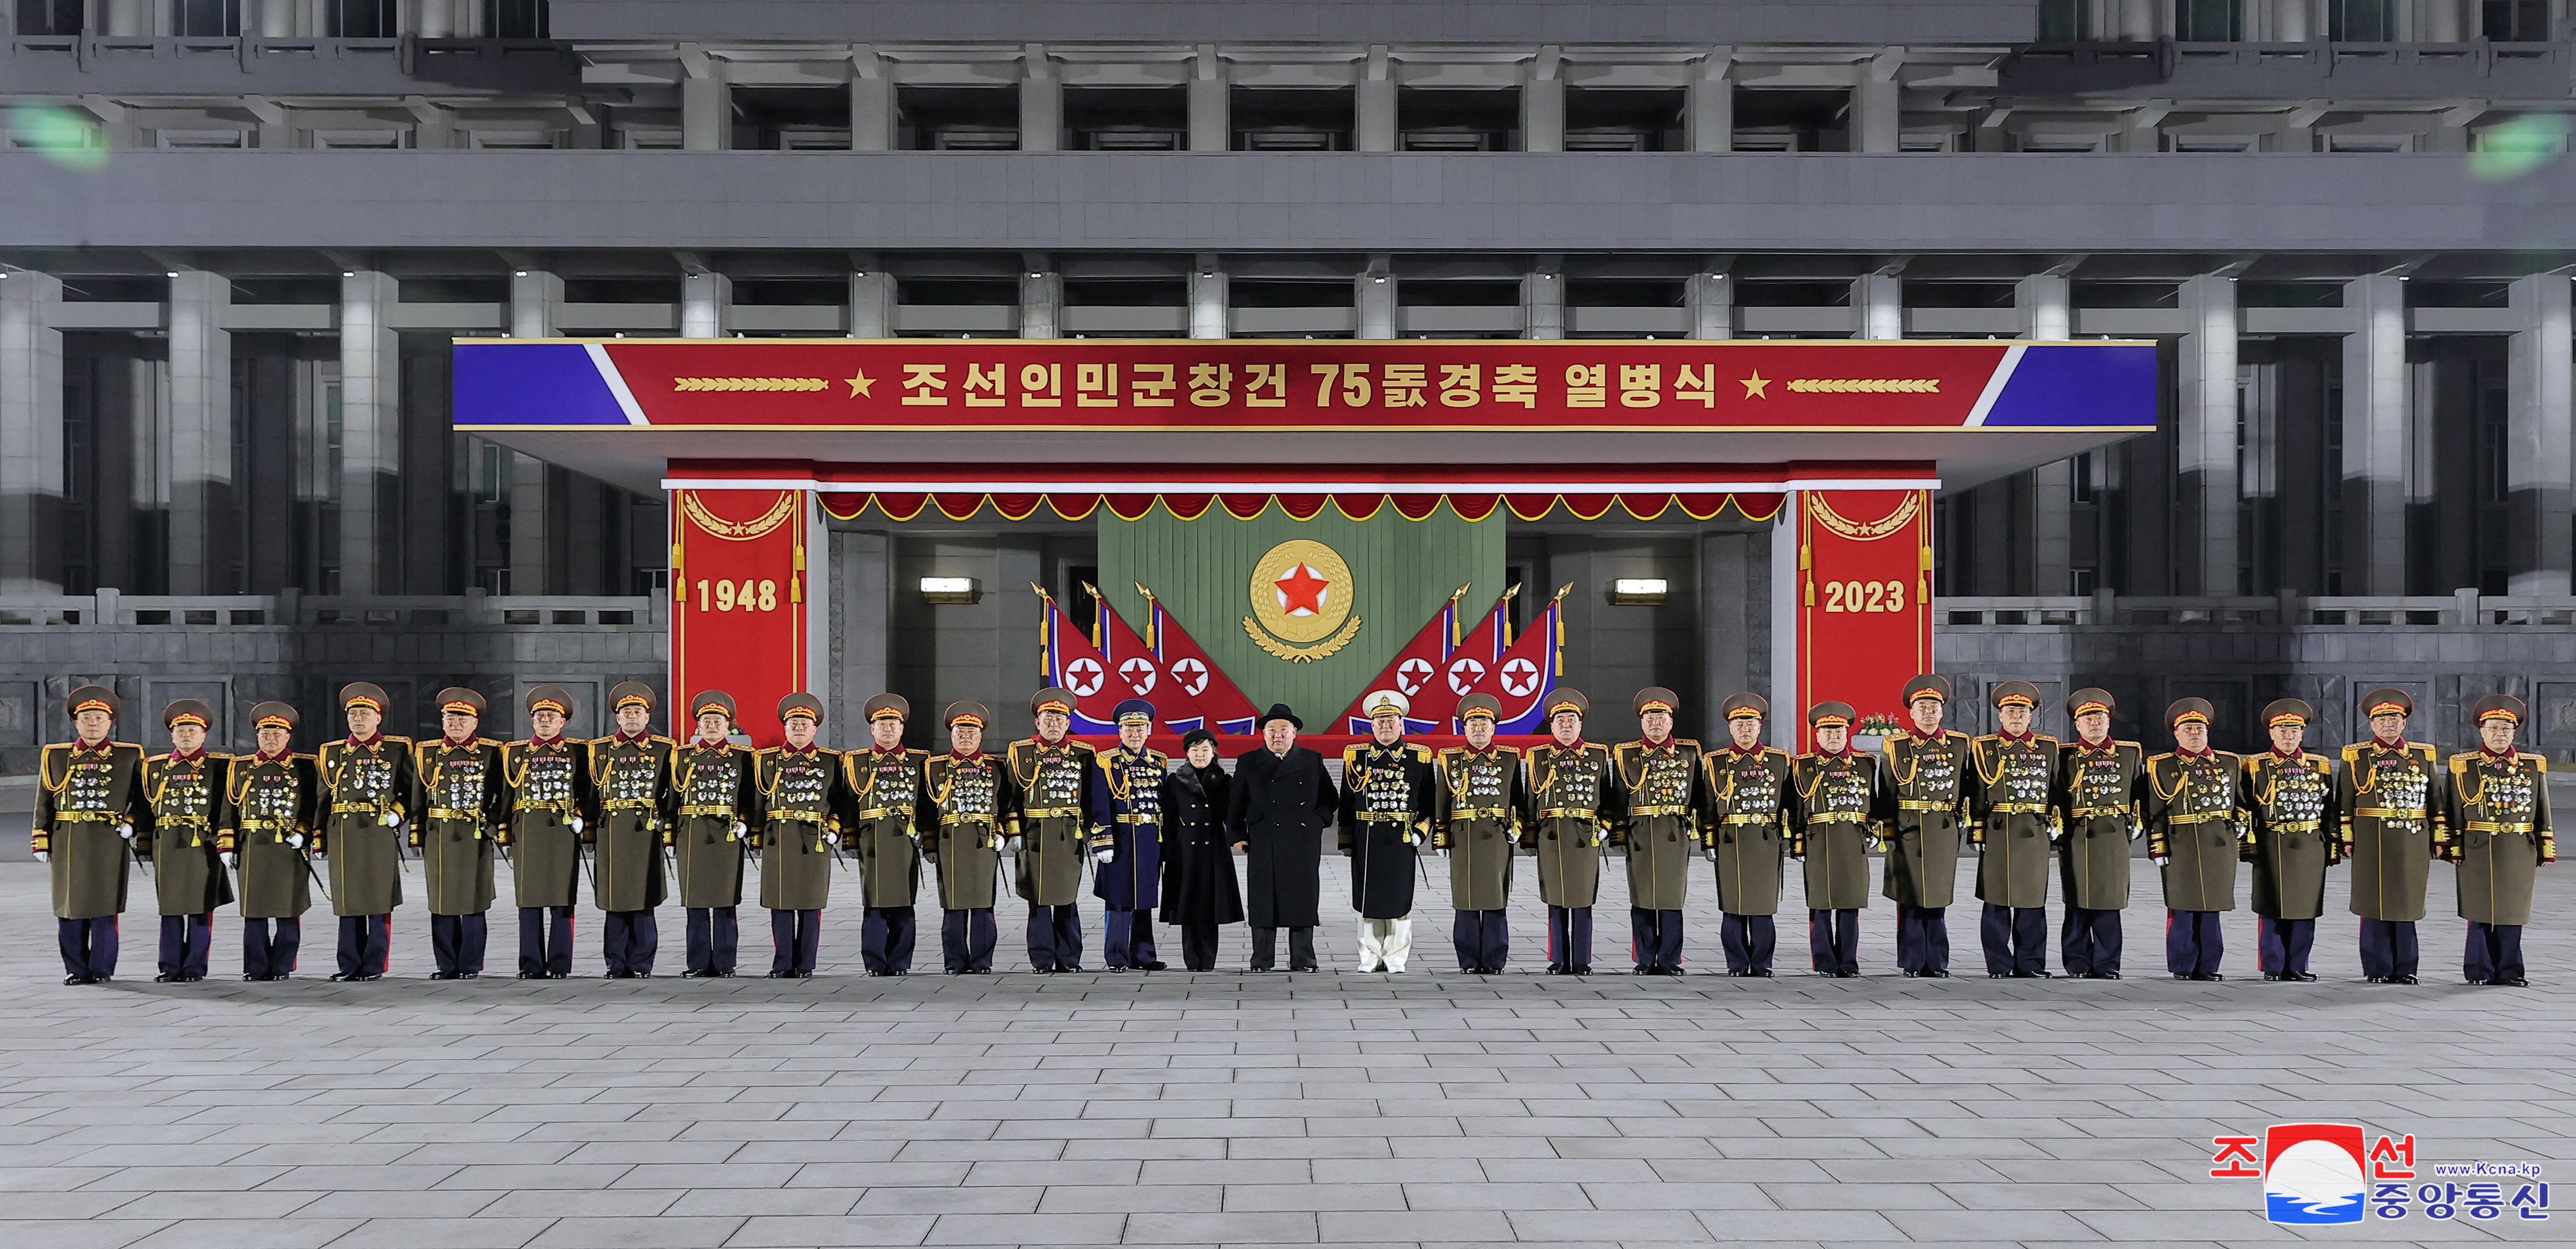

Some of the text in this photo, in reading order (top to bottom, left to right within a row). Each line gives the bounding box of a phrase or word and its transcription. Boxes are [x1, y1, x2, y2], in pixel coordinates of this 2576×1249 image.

[901, 363, 1286, 407] 조선인민군창건
[1565, 364, 1715, 408] 열병식
[697, 579, 777, 612] 1948
[1825, 580, 1905, 613] 2023
